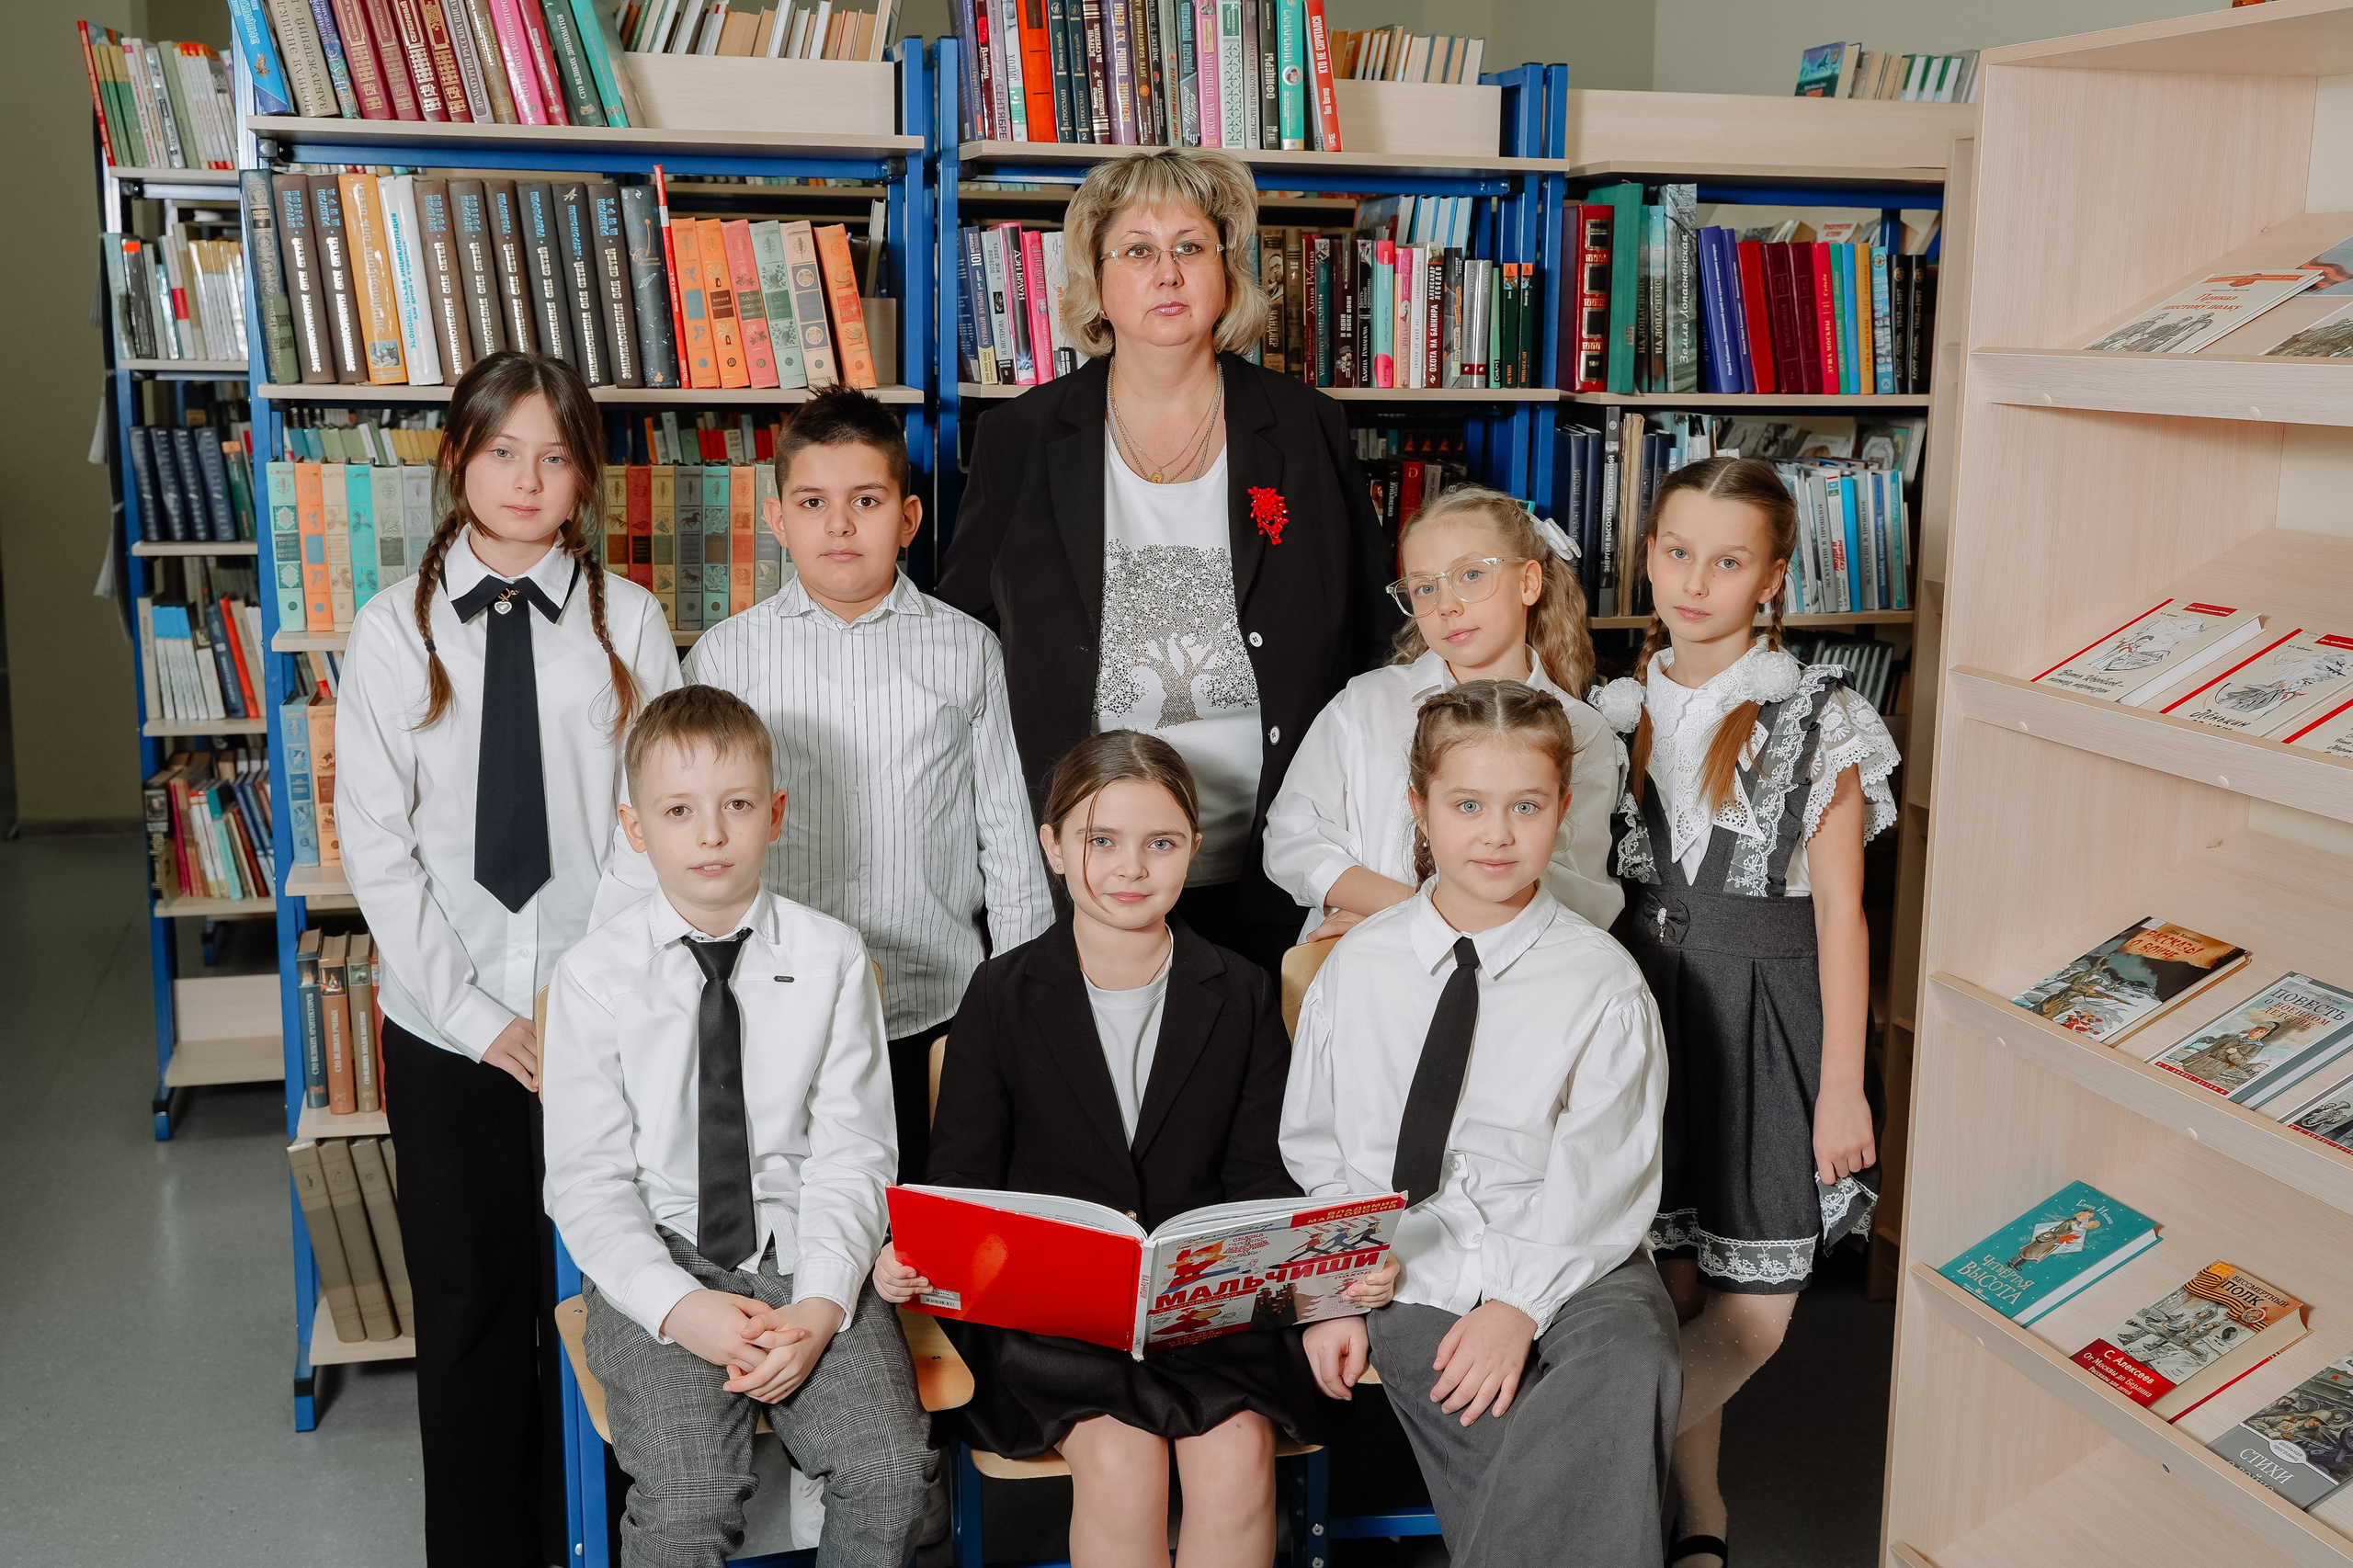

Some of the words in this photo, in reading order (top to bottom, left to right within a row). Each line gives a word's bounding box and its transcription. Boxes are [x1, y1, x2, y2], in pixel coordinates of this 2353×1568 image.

[1114, 3, 1126, 27] ВЕКА
[458, 23, 472, 57] РУССКИХ
[556, 14, 574, 56] ДИПЛОМАТОВ
[1074, 34, 1082, 51] судьба
[1087, 29, 1096, 57] ВСТРЕЧИ
[1094, 23, 1102, 52] СРЕТЕНКЕ
[1134, 10, 1146, 59] БОЖЕСТВЕННОЙ
[1150, 34, 1160, 62] ДЖЕЙМС
[1283, 9, 1295, 62] САМАРСКИЙ
[1312, 16, 1326, 51] СПРЯТАЛСЯ
[295, 17, 328, 109] ЗАБЛУЖДЕНИЙ
[514, 51, 528, 83] ВЕЛИКИХ
[570, 57, 584, 85] ВЕЛИКИХ
[980, 47, 990, 79] Вампиры
[1006, 54, 1017, 81] ХОЛМС
[1096, 52, 1103, 62] НА
[1117, 48, 1128, 77] ТАЙНЫ
[1140, 62, 1148, 79] ДЕТИ
[1316, 51, 1326, 60] НЕ
[1318, 62, 1328, 74] КТО
[293, 60, 313, 111] ПОЛНАЯ
[465, 58, 483, 108] ДРАМАТУРГИЯ
[522, 84, 531, 98] СТО
[1204, 55, 1215, 97] ПУШКИНА
[1265, 53, 1277, 99] ОФИЦЕРЫ
[578, 85, 587, 99] СТО
[1097, 79, 1106, 116] КОНДРАТЬЕВ
[1119, 82, 1131, 122] ВЕЛИКИЕ
[1183, 86, 1191, 125] Владимир
[995, 85, 1007, 139] СЕНТЯБРЕ
[1078, 90, 1086, 128] В.ГРОССМАН
[1207, 103, 1217, 136] ОКСАНА
[290, 189, 305, 228] РОССИИ
[317, 188, 332, 227] РЕЛИГИИ
[354, 182, 369, 217] ДЕТЕЙ
[432, 194, 447, 232] РОССИИ
[469, 194, 483, 232] РОССИИ
[496, 193, 512, 234] ГЕОЛОГИЯ
[529, 191, 546, 238] ГЕОГРАФИЯ
[358, 219, 372, 243] ДЛЯ
[567, 205, 583, 256] АСТРОНОМИЯ
[596, 199, 608, 237] РЕЛИГИИ
[291, 237, 307, 268] ДЕТЕЙ
[326, 237, 343, 267] ДЕТЕЙ
[392, 213, 406, 278] ЭНЦИКЛОПЕДИЯ
[403, 241, 412, 276] взрослых
[433, 242, 449, 272] ДЕТЕЙ
[469, 242, 484, 272] ДЕТЕЙ
[503, 243, 518, 273] ДЕТЕЙ
[971, 253, 983, 267] 101
[1013, 249, 1024, 268] ДЭН
[537, 246, 552, 277] ДЕТЕЙ
[573, 260, 588, 289] ДЕТЕЙ
[604, 247, 620, 278] ДЕТЕЙ
[1306, 251, 1317, 286] Рубина
[1680, 233, 1689, 319] Лопасненская
[298, 271, 310, 291] ДЛЯ
[333, 270, 345, 290] ДЛЯ
[363, 246, 386, 335] ЭНЦИКЛОПЕДИЯ
[409, 284, 417, 305] детей
[440, 274, 451, 294] ДЛЯ
[475, 275, 487, 295] ДЛЯ
[509, 276, 521, 296] ДЛЯ
[543, 278, 554, 299] ДЛЯ
[610, 279, 622, 300] ДЛЯ
[1015, 270, 1026, 301] БРАУН
[1435, 266, 1443, 301] ЛЕБЕДЕВ
[578, 290, 589, 310] ДЛЯ
[977, 290, 985, 314] БУЛЬОН
[1306, 288, 1317, 314] Дина
[2194, 293, 2239, 302] Приказ
[401, 280, 416, 349] ЭКОНОМИЧЕСКАЯ
[1429, 303, 1438, 337] БАНКИРА
[1781, 303, 1791, 347] МОСКОВИЯ
[1872, 276, 1887, 373] ПОДМОСКОВЬЕ
[301, 294, 323, 373] ЭНЦИКЛОПЕДИЯ
[335, 293, 357, 372] ЭНЦИКЛОПЕДИЯ
[443, 298, 464, 376] ЭНЦИКЛОПЕДИЯ
[613, 303, 632, 380] ЭНЦИКЛОПЕДИЯ
[978, 316, 989, 346] КУРИНЫЙ
[998, 319, 1006, 349] НЕСТЕРОВА
[1429, 338, 1438, 348] НА
[1679, 323, 1689, 364] Земля
[1824, 320, 1833, 351] МОСКВЫ
[581, 312, 600, 383] ЭНЦИКЛОПЕДИЯ
[1429, 350, 1438, 372] ОХОТА
[1655, 339, 1664, 355] НА
[1401, 347, 1409, 381] РУССКАЯ
[1826, 354, 1835, 374] ДУША
[1573, 469, 1581, 495] ЛЮДИ
[1606, 454, 1615, 506] ДОСТИЖЕНИЙ
[1572, 510, 1580, 540] ВРЕМЯ
[1605, 506, 1613, 541] ВЫСОКИХ
[1818, 503, 1826, 539] ПРОШЛОЕ
[1603, 542, 1611, 574] ЭНЕРГИЯ
[1823, 548, 1832, 589] ЭКСКУРСИИ
[2189, 709, 2252, 728] Лёнькин
[2129, 938, 2144, 947] О
[2143, 930, 2205, 956] РАССКАЗЫ
[306, 992, 317, 1036] АРХИТЕКТОРОВ
[2262, 1006, 2314, 1029] ДЕТСТВЕ
[2269, 988, 2347, 1022] ПОВЕСТЬ
[2272, 1000, 2331, 1028] ВОЕННОМ
[309, 1036, 319, 1062] ВЕЛИКИХ
[332, 1033, 342, 1060] ВЕЛИКИХ
[311, 1062, 320, 1075] СТО
[334, 1060, 343, 1073] СТО
[1307, 1204, 1398, 1223] МАЯКОВСКИЙ
[1326, 1199, 1399, 1216] ВЛАДИМИР
[1155, 1251, 1380, 1310] МАЛЬЧИШИ
[1334, 1270, 1372, 1280] ПОХОД
[1956, 1260, 2023, 1306] ВЫСОТА
[1983, 1253, 2036, 1290] ЧЕТВЁРТАЯ
[1170, 1291, 1239, 1311] МОГИЛЕВСКАЯ
[2219, 1280, 2266, 1307] ПОЛК
[2231, 1275, 2290, 1308] БЕССМЕРТНЫЙ
[2083, 1351, 2094, 1362] От
[2091, 1357, 2119, 1378] Москвы
[2116, 1373, 2127, 1382] до
[2125, 1378, 2153, 1398] Берлина
[2087, 1366, 2111, 1385] Рассказы
[2116, 1383, 2131, 1397] детей
[2103, 1348, 2116, 1360] С.
[2113, 1357, 2155, 1385] Алексеев
[2239, 1448, 2295, 1486] СТИХИ
